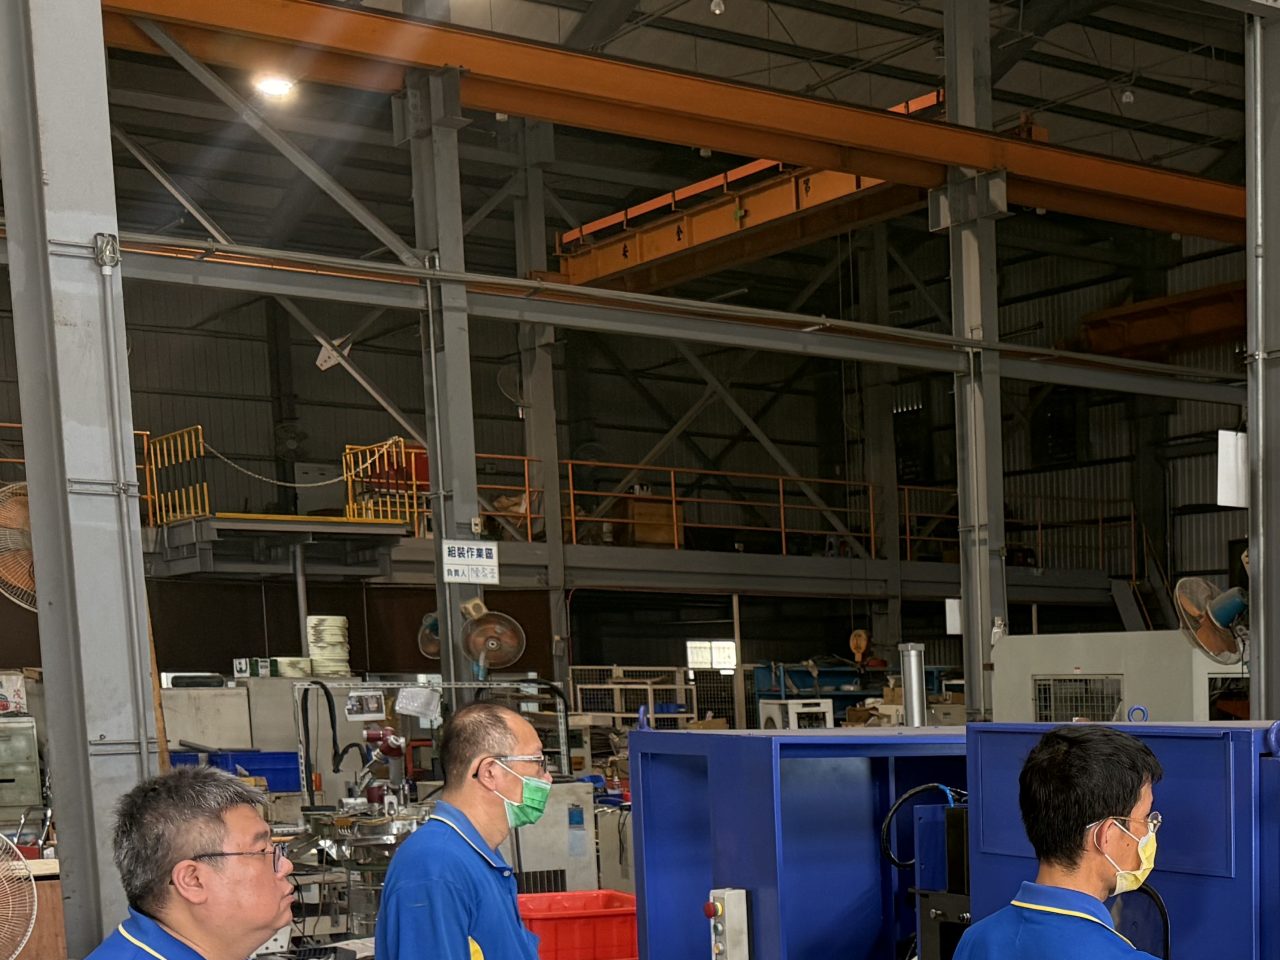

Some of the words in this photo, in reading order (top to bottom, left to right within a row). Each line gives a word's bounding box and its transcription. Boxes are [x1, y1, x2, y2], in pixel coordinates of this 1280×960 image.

[447, 546, 493, 560] 組裝作業區
[447, 569, 467, 577] 負責人
